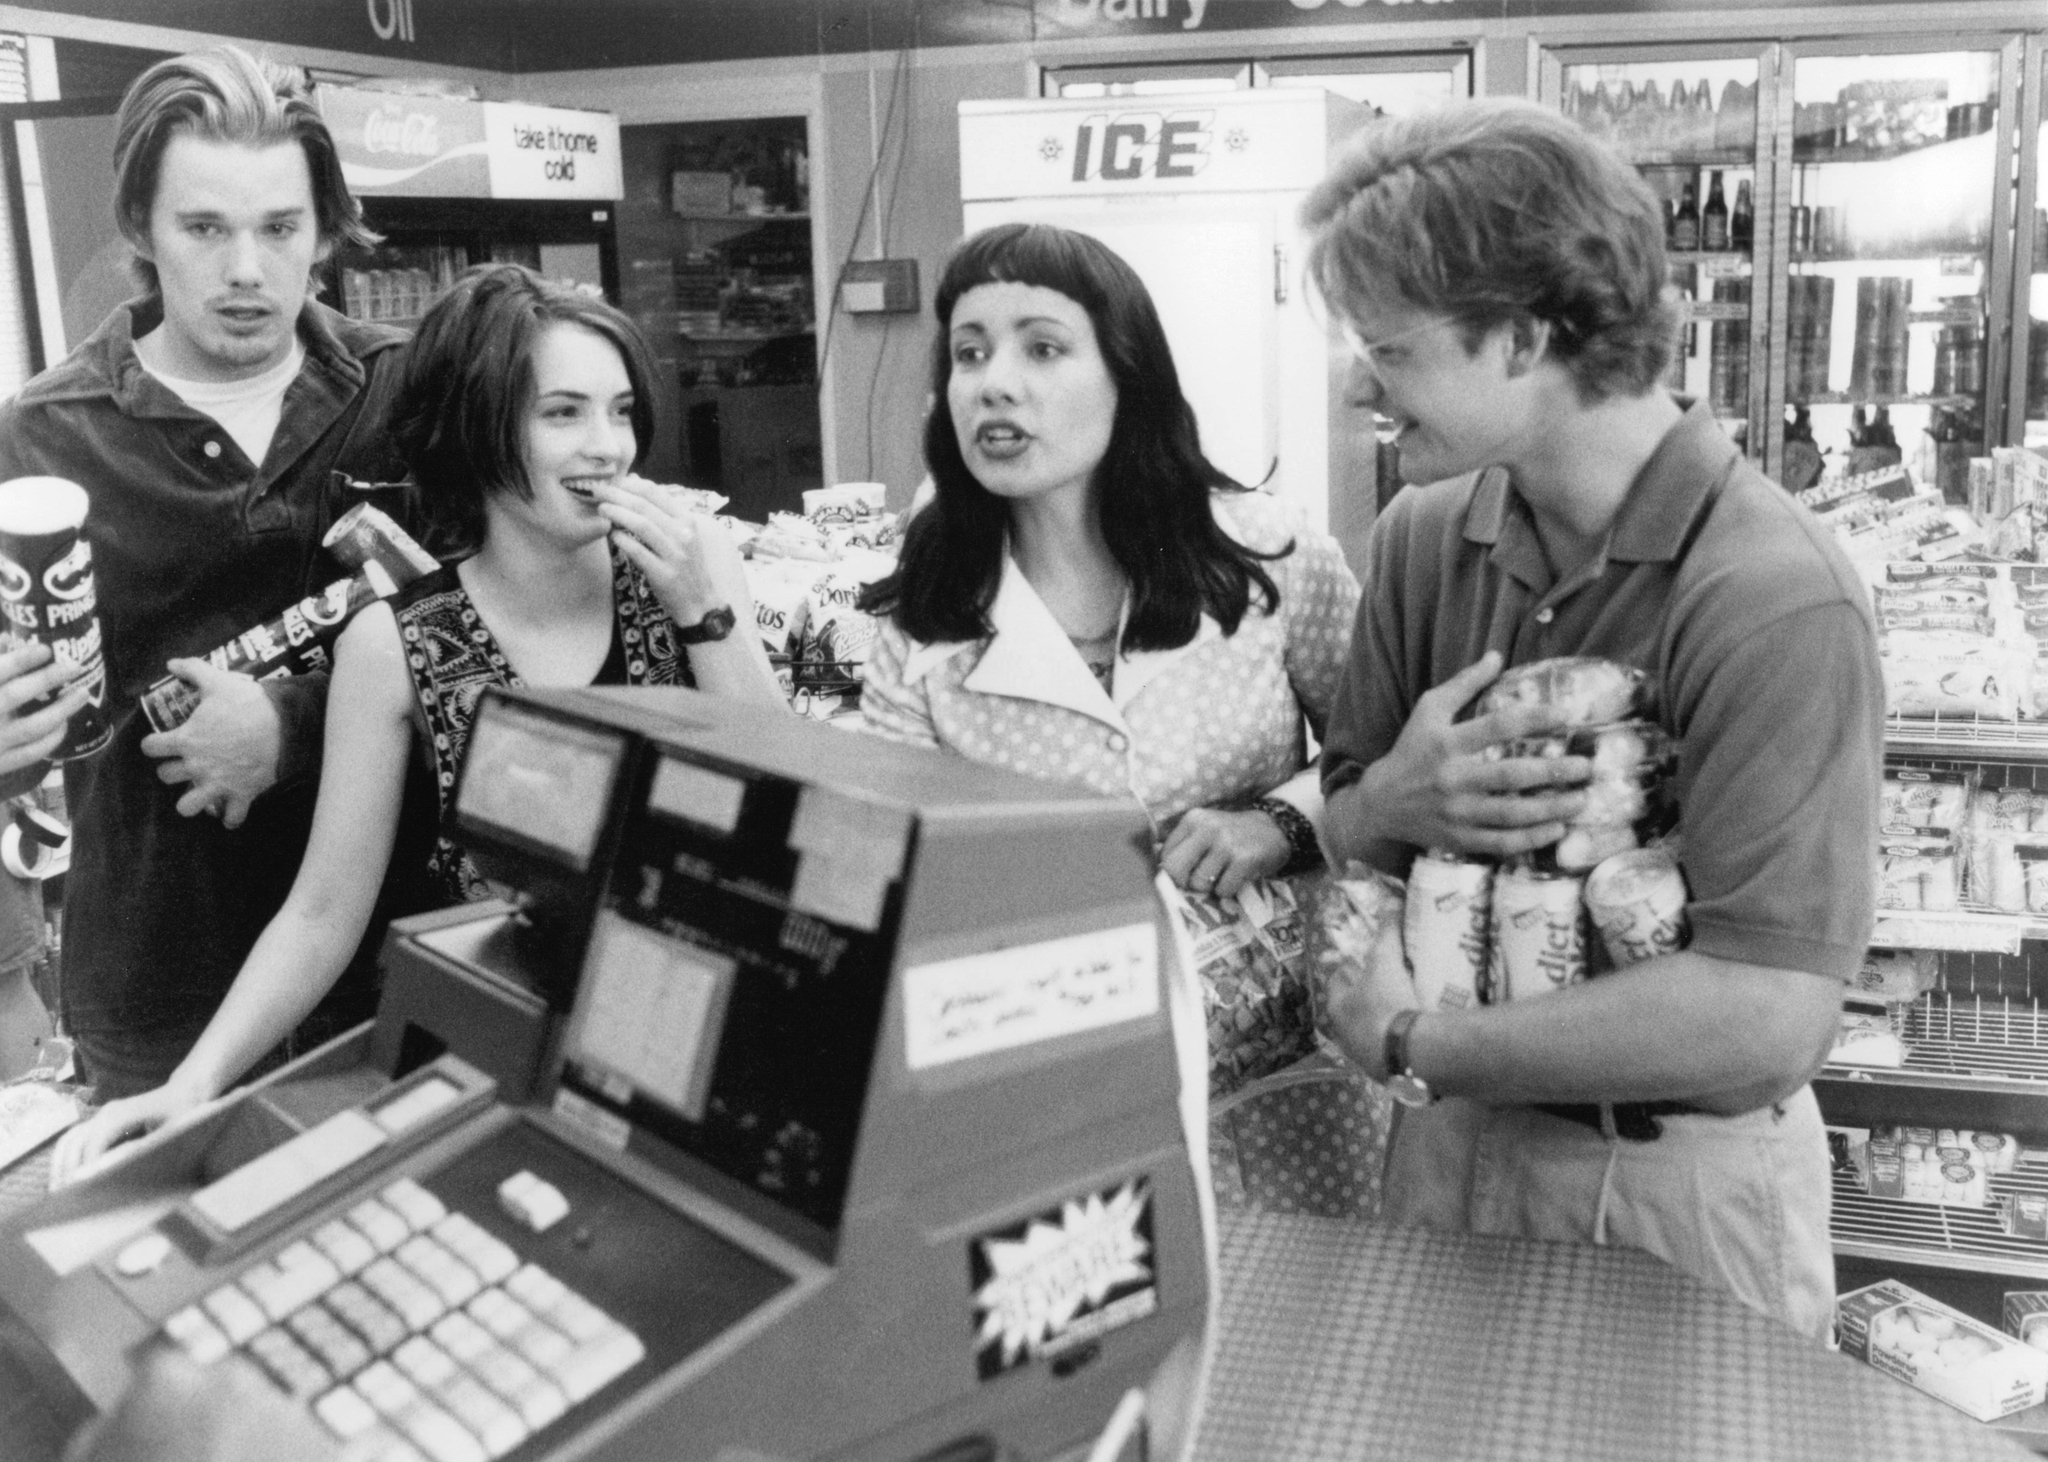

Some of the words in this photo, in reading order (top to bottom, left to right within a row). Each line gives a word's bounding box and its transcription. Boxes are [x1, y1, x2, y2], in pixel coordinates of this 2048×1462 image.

[513, 124, 545, 149] take
[562, 127, 598, 154] home
[1072, 111, 1214, 182] ICE
[544, 156, 576, 181] cold
[1536, 920, 1570, 984] diet
[1871, 1343, 1918, 1376] Powdered
[1871, 1354, 1914, 1384] Donettes
